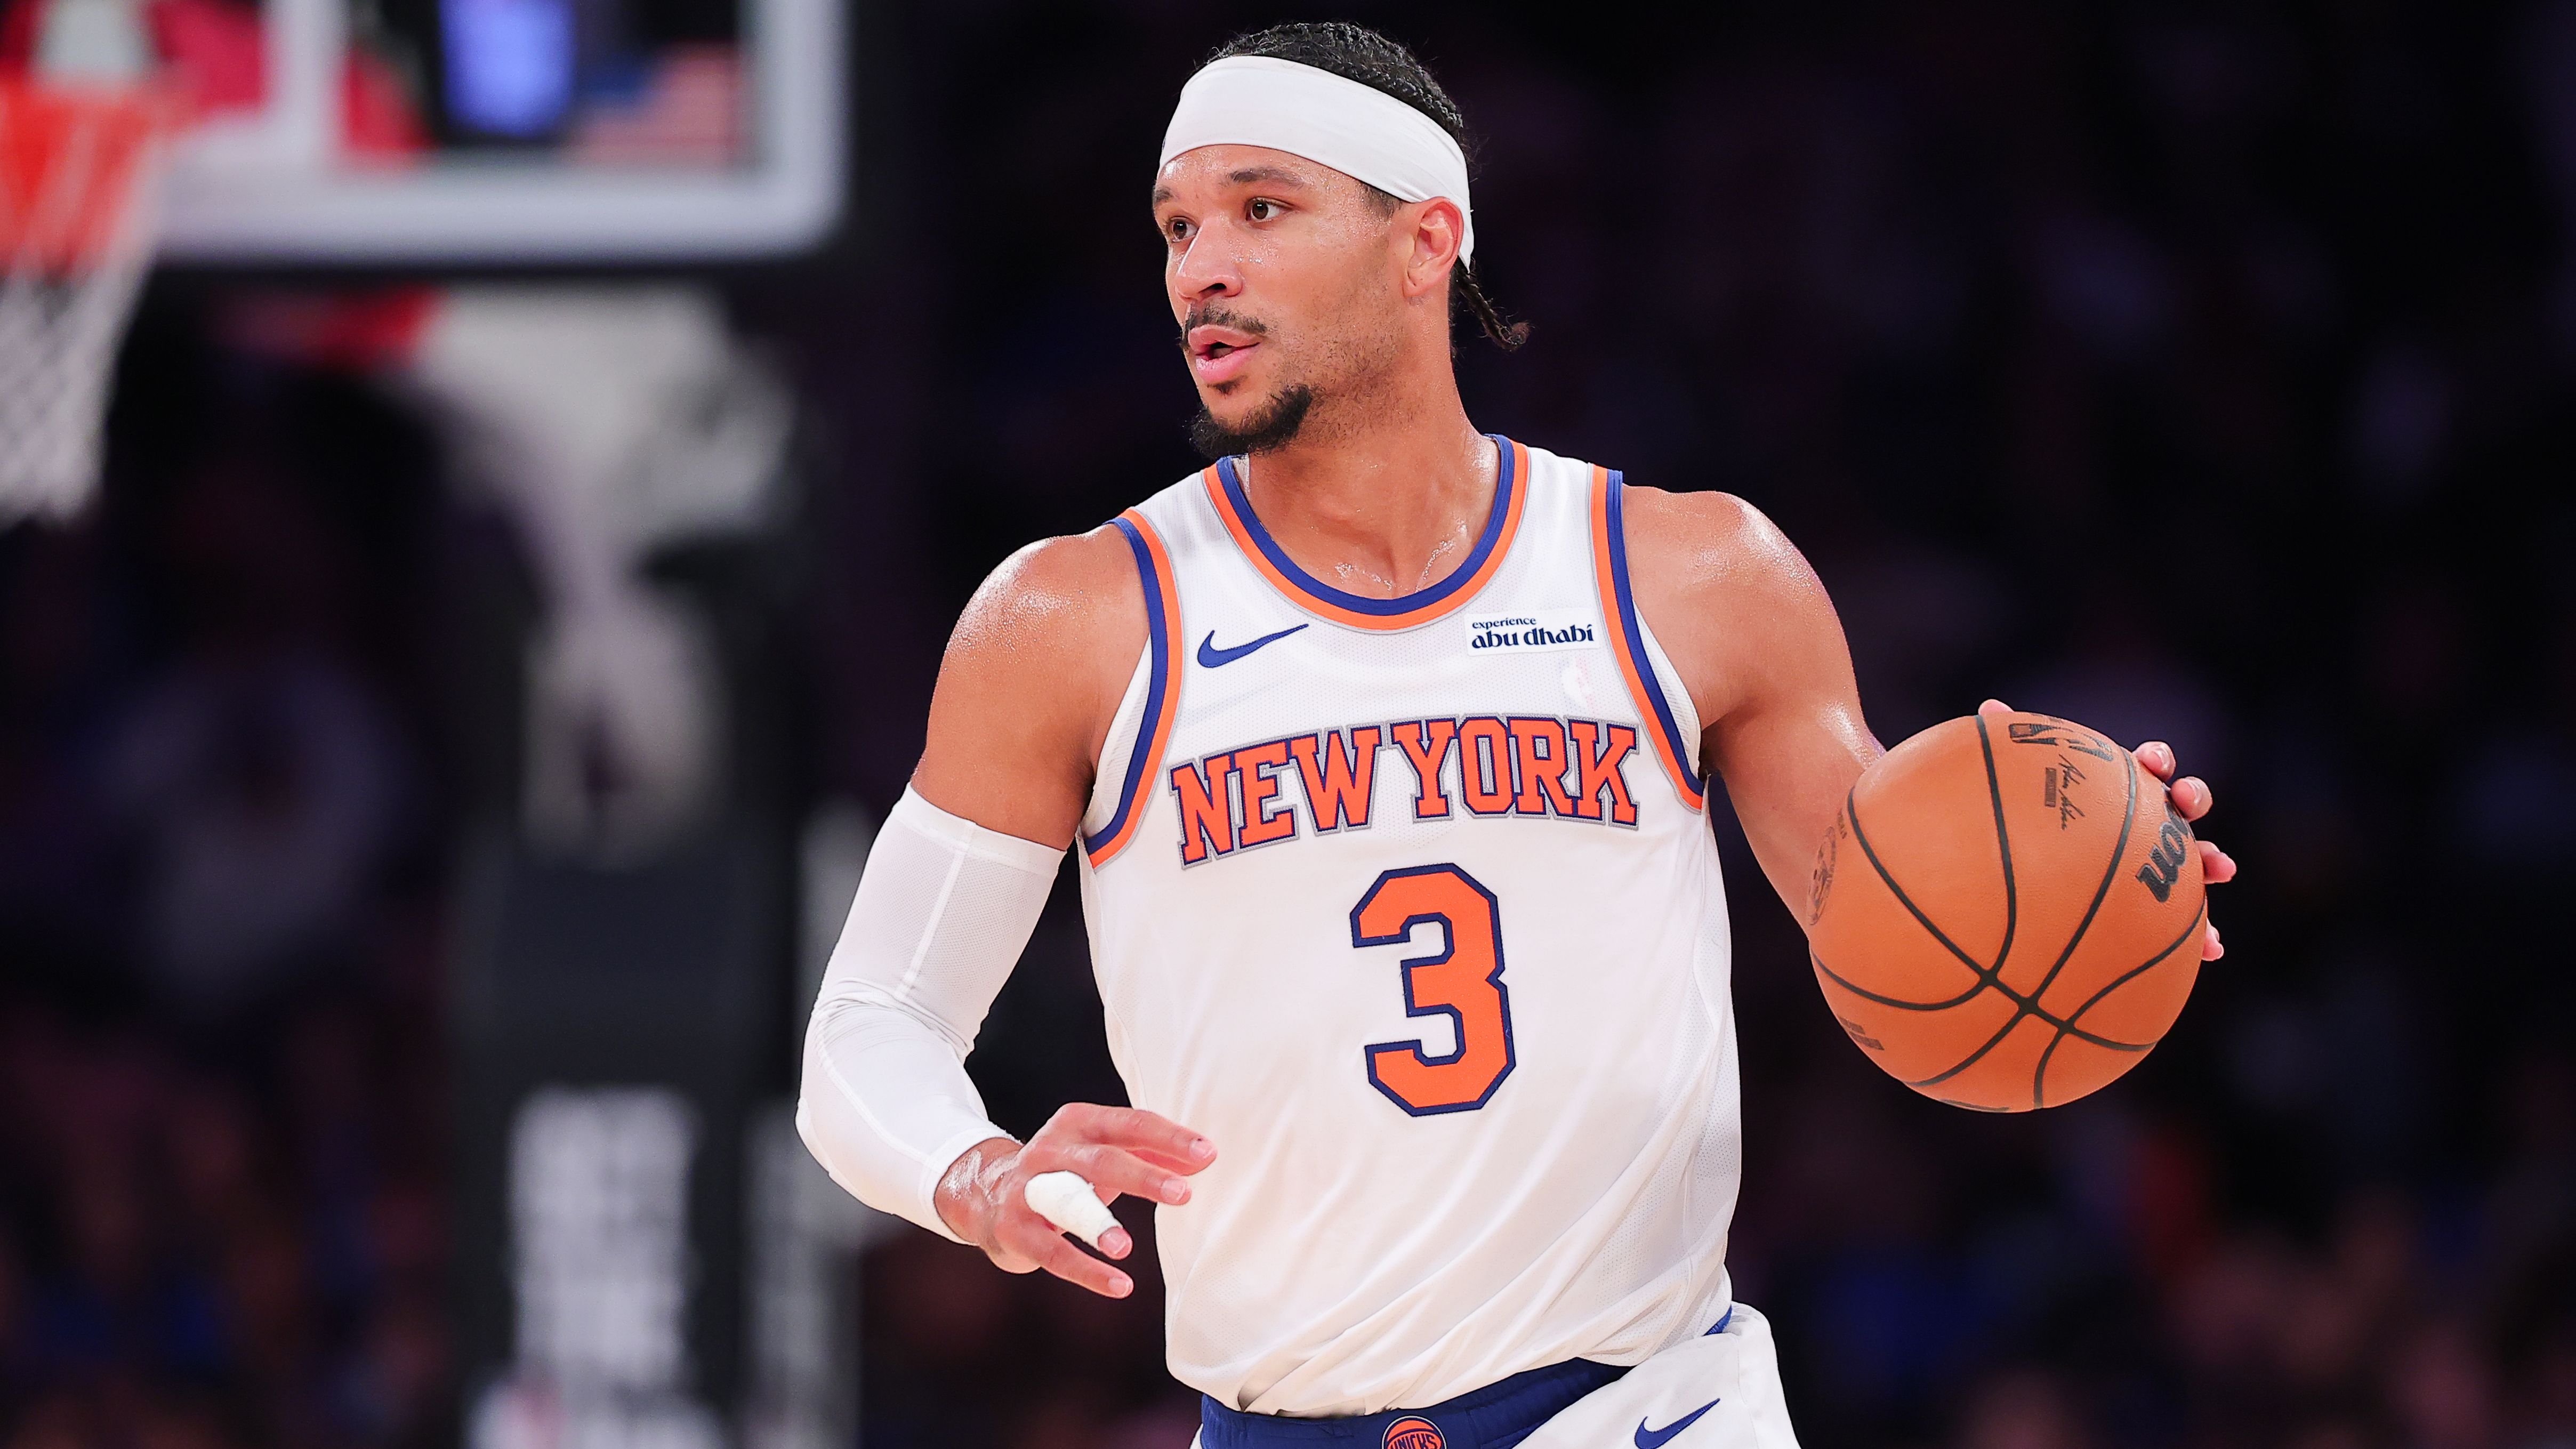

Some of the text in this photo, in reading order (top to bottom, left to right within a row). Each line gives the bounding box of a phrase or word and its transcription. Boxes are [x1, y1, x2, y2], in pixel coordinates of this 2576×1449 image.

[1471, 624, 1594, 648] abu dhabi
[1472, 617, 1536, 630] experience
[1166, 713, 1640, 870] NEW YORK
[1350, 863, 1516, 1117] 3
